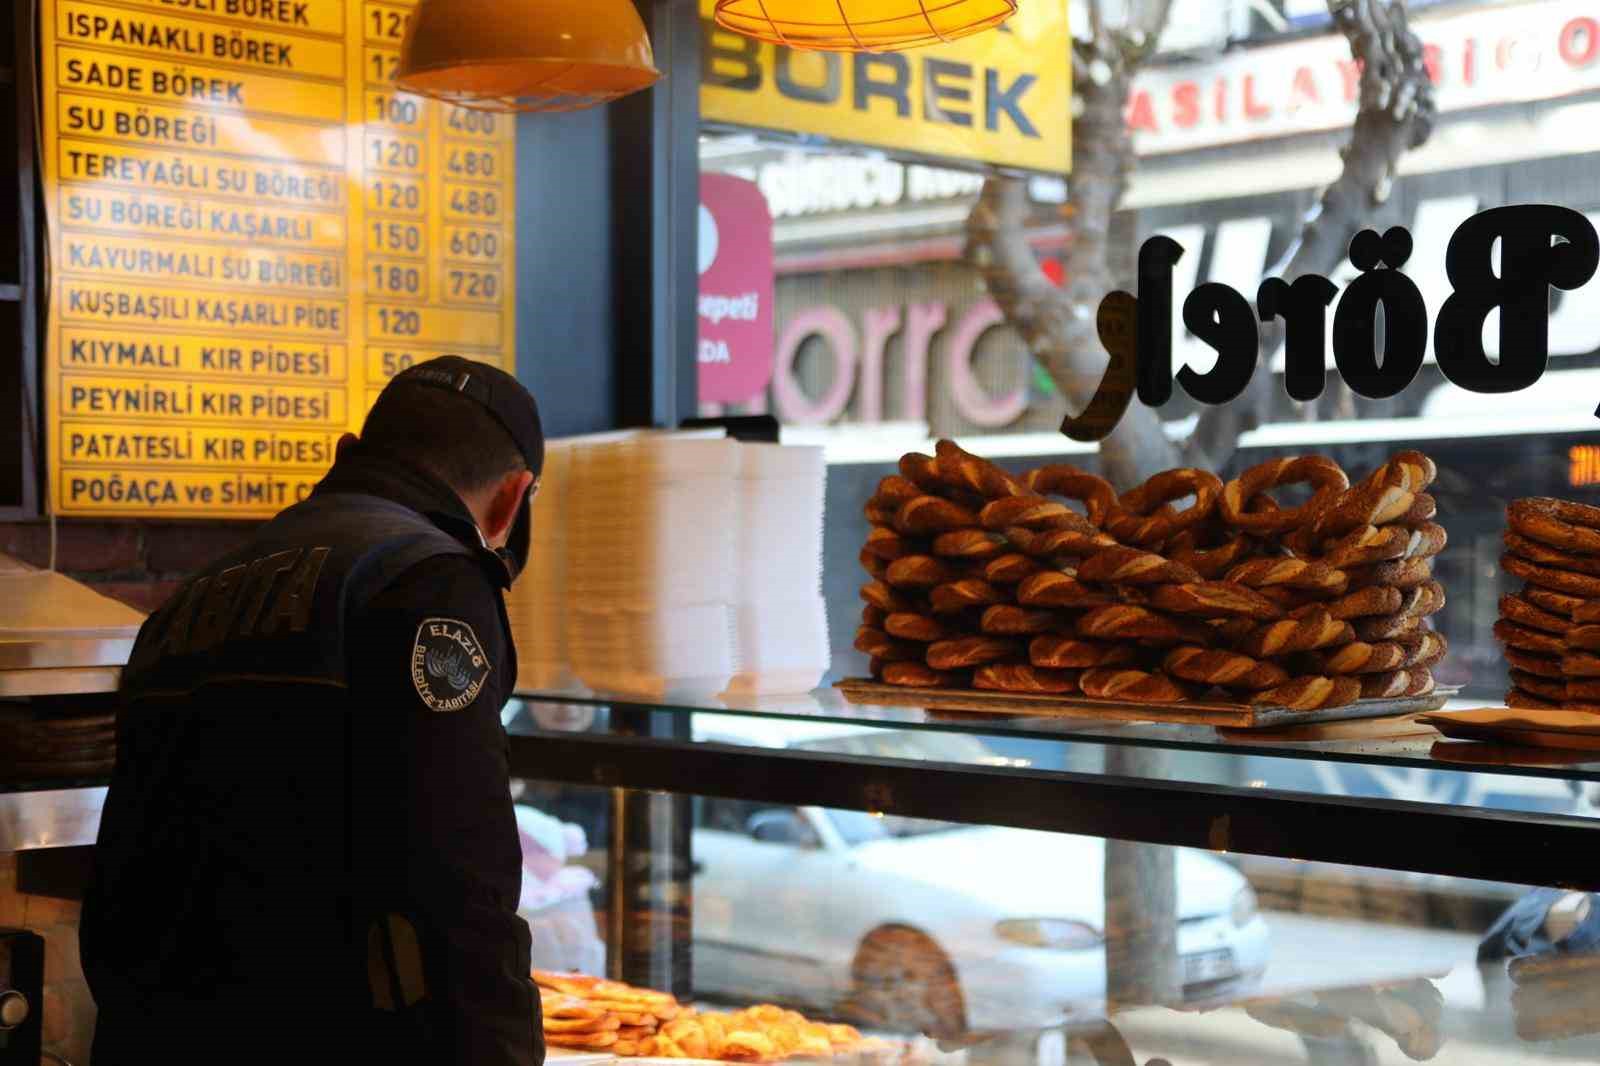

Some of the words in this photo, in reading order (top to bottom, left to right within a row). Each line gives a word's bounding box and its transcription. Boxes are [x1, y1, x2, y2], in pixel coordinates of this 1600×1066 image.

[67, 12, 204, 54] ISPANAKLI
[213, 30, 293, 67] BÖREK
[372, 10, 412, 38] 12
[67, 60, 142, 90] SADE
[152, 67, 244, 103] BÖREK
[67, 106, 104, 131] SU
[115, 107, 217, 145] BÖREĞİ
[375, 96, 417, 125] 100
[449, 108, 495, 135] 400
[68, 151, 209, 187] TEREYAĞLI
[217, 168, 247, 192] SU
[373, 139, 419, 167] 120
[449, 151, 495, 176] 480
[68, 196, 102, 220] SU
[111, 195, 202, 230] BÖREĞİ
[211, 211, 313, 240] KAŞARLI
[374, 183, 420, 209] 120
[450, 191, 497, 216] 480
[374, 223, 420, 251] 150
[450, 231, 497, 257] 600
[68, 244, 214, 278] KAVURMALI
[222, 258, 251, 281] SU
[259, 257, 341, 288] BÖREĞİ
[374, 265, 420, 293] 180
[450, 271, 497, 297] 720
[69, 289, 190, 319] KUŞBAŞILI
[197, 300, 289, 325] KAŞARLI
[295, 303, 341, 330] PİDE
[379, 308, 421, 335] 120
[71, 339, 180, 367] KIYMALI
[201, 348, 243, 370] KIR
[251, 345, 330, 375] PİDESİ
[71, 384, 193, 414] PEYNİRLİ
[202, 393, 243, 416] KIR
[251, 389, 330, 419] PİDESİ
[71, 431, 193, 460] PATATESLİ
[203, 438, 246, 461] KIR
[254, 434, 332, 463] PİDESİ
[71, 474, 178, 507] POĞAÇA
[185, 485, 214, 502] ve
[220, 472, 288, 504] SİMİT
